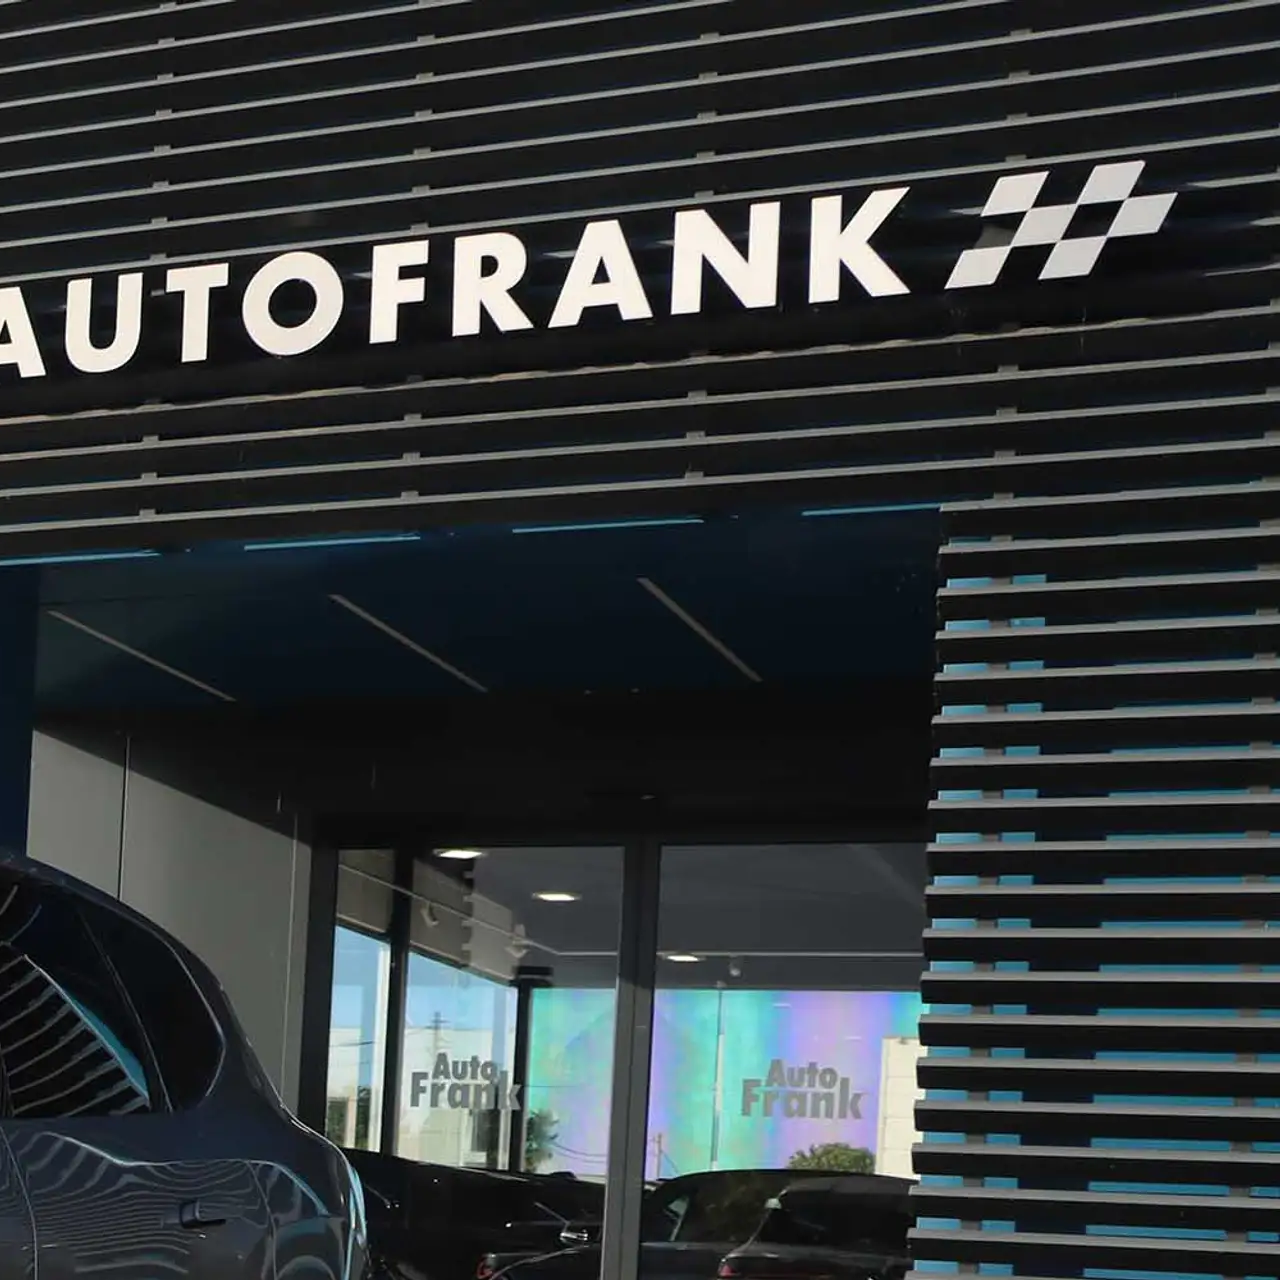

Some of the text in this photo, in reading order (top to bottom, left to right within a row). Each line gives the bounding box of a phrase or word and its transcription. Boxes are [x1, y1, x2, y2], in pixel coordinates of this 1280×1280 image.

[431, 1052, 498, 1080] Auto
[765, 1059, 838, 1089] Auto
[410, 1070, 522, 1110] Frank
[741, 1077, 867, 1119] Frank
